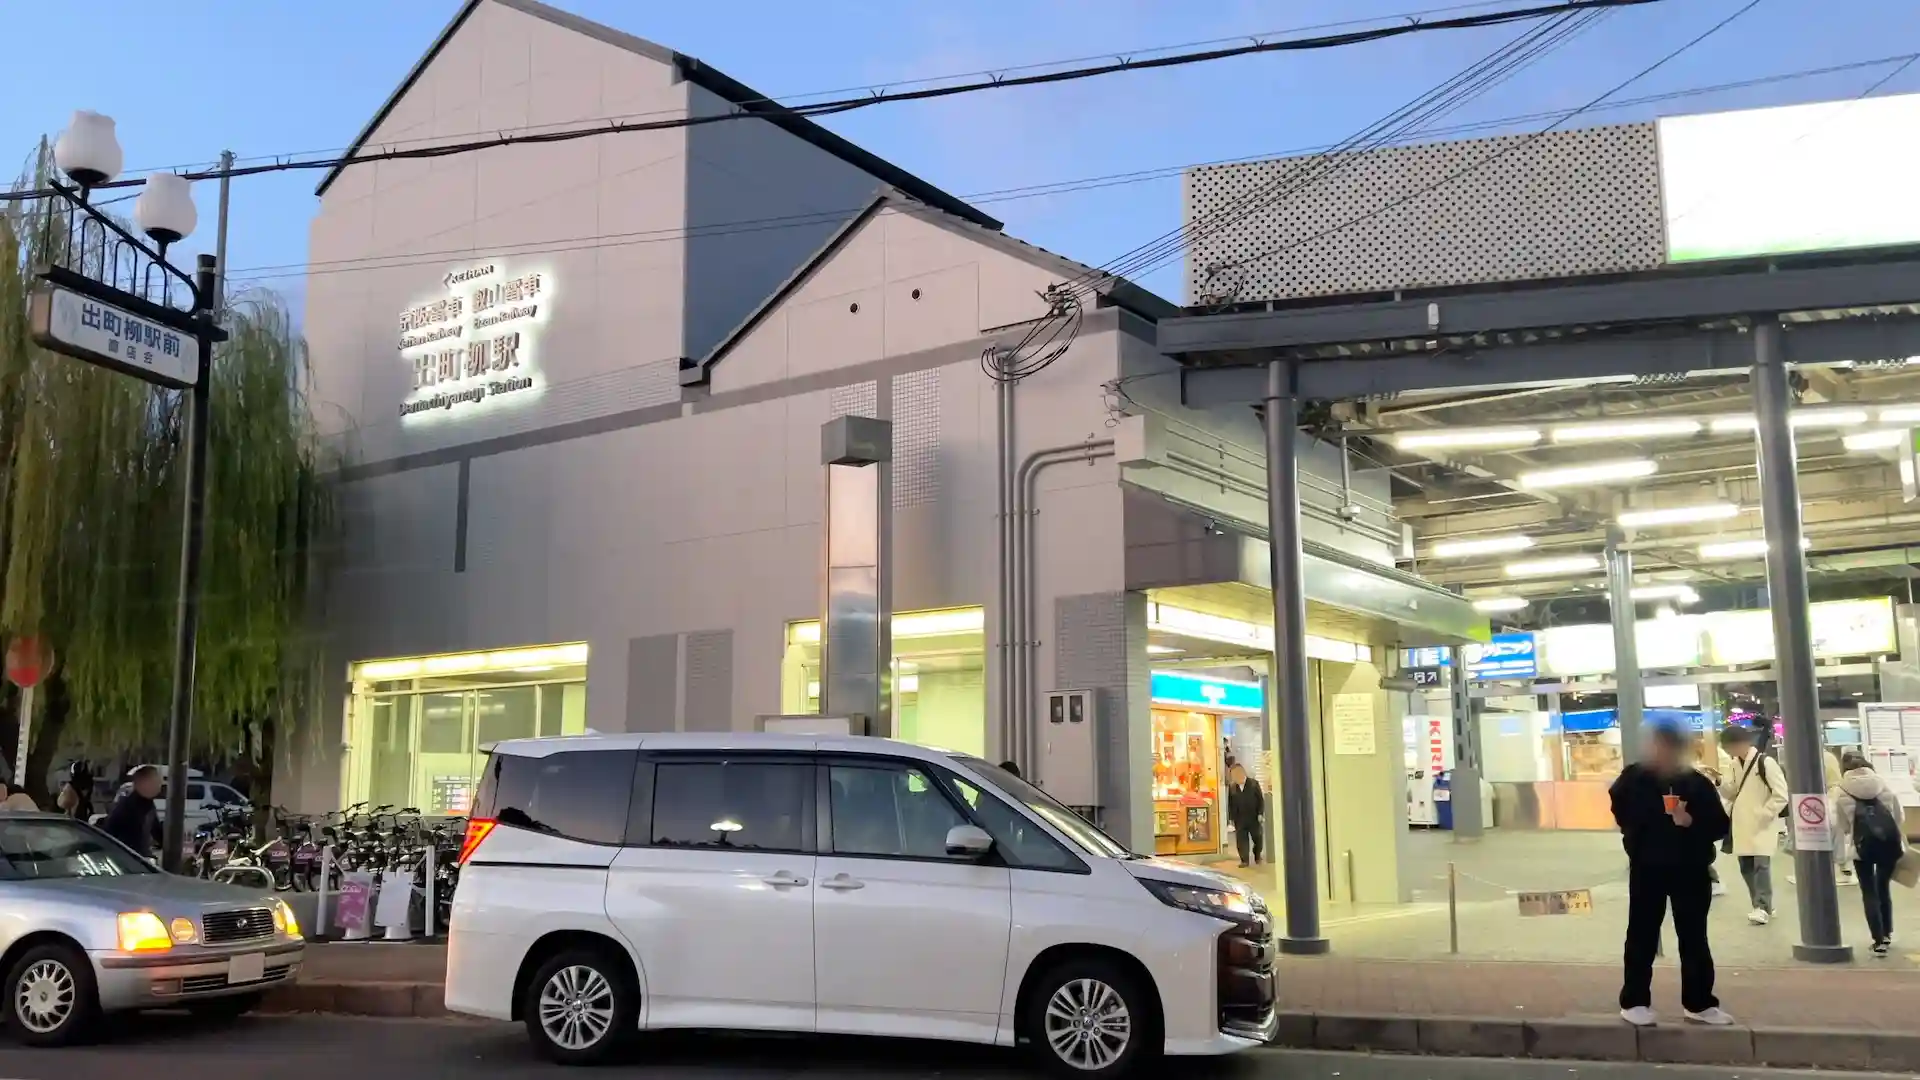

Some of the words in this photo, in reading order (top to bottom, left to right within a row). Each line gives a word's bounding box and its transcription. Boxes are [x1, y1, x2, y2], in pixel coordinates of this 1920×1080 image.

[81, 303, 180, 358] 出町柳駅前
[413, 332, 519, 390] 出町柳駅
